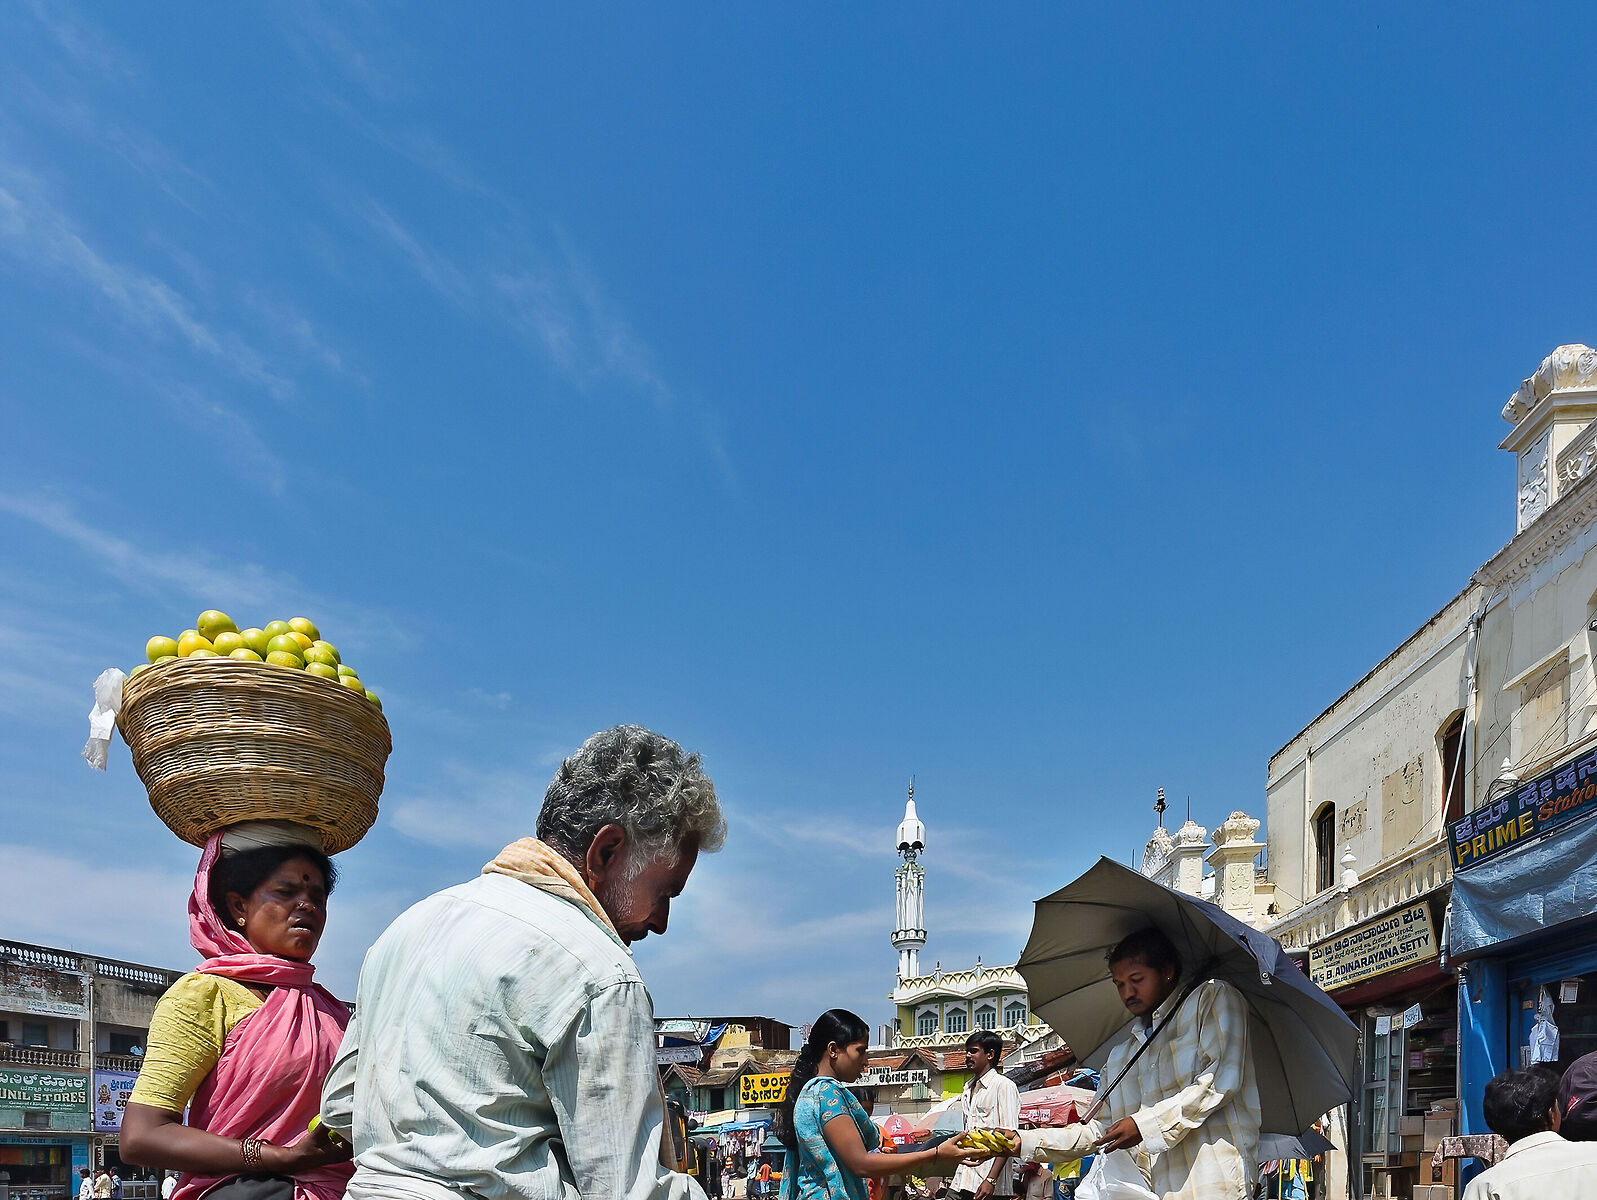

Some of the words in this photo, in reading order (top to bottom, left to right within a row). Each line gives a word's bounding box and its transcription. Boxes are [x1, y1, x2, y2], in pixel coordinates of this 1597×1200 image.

[1455, 811, 1535, 865] PRIME
[1335, 948, 1400, 977] ADINARAYANA
[1399, 934, 1430, 955] SETTY
[34, 1091, 86, 1103] STORES
